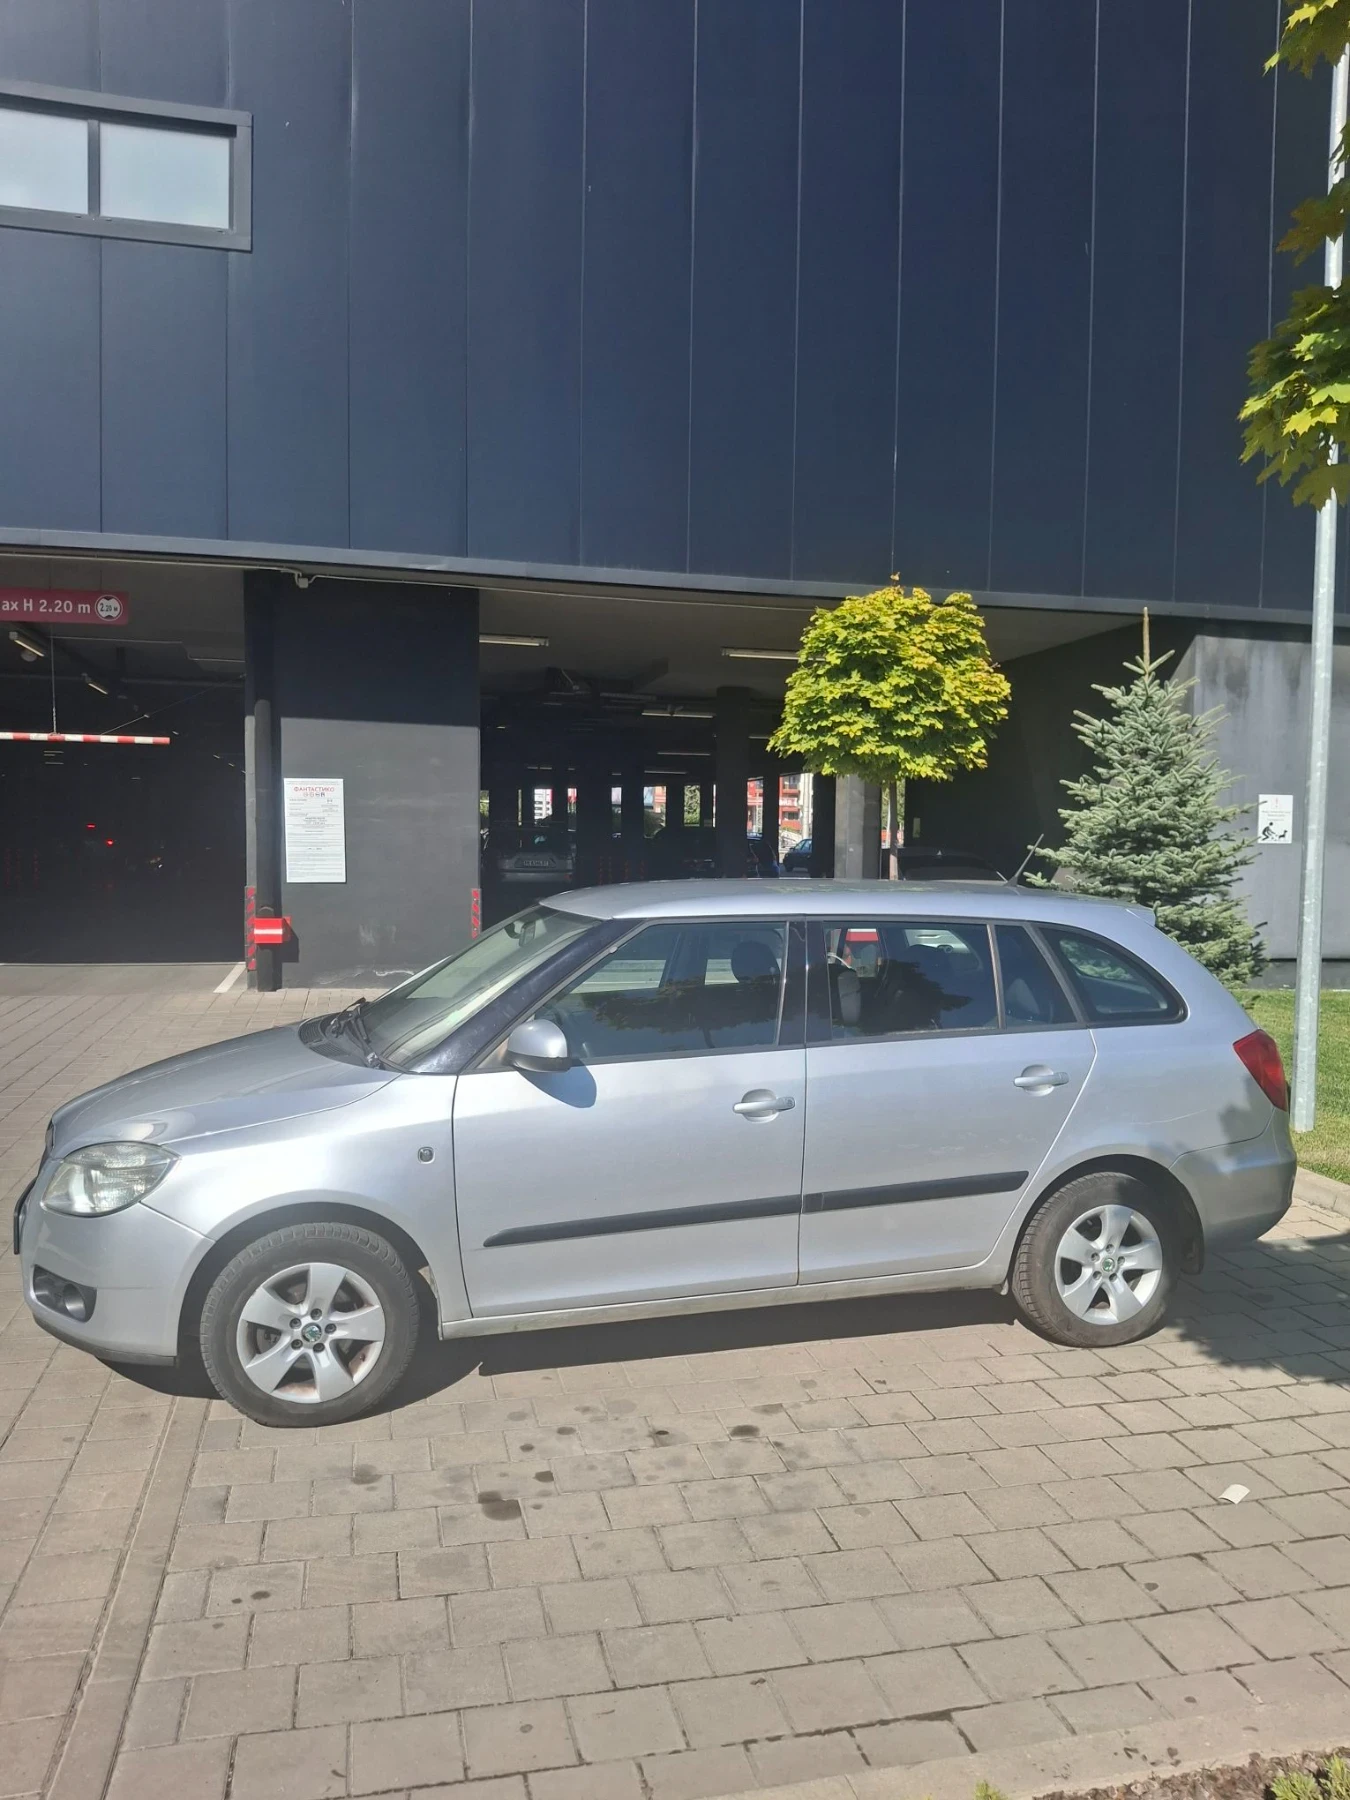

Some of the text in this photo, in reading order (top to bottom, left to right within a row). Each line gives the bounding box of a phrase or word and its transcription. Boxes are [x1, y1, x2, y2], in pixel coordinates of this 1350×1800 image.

[23, 598, 33, 612] H
[39, 600, 73, 613] 2.20
[77, 603, 91, 614] m
